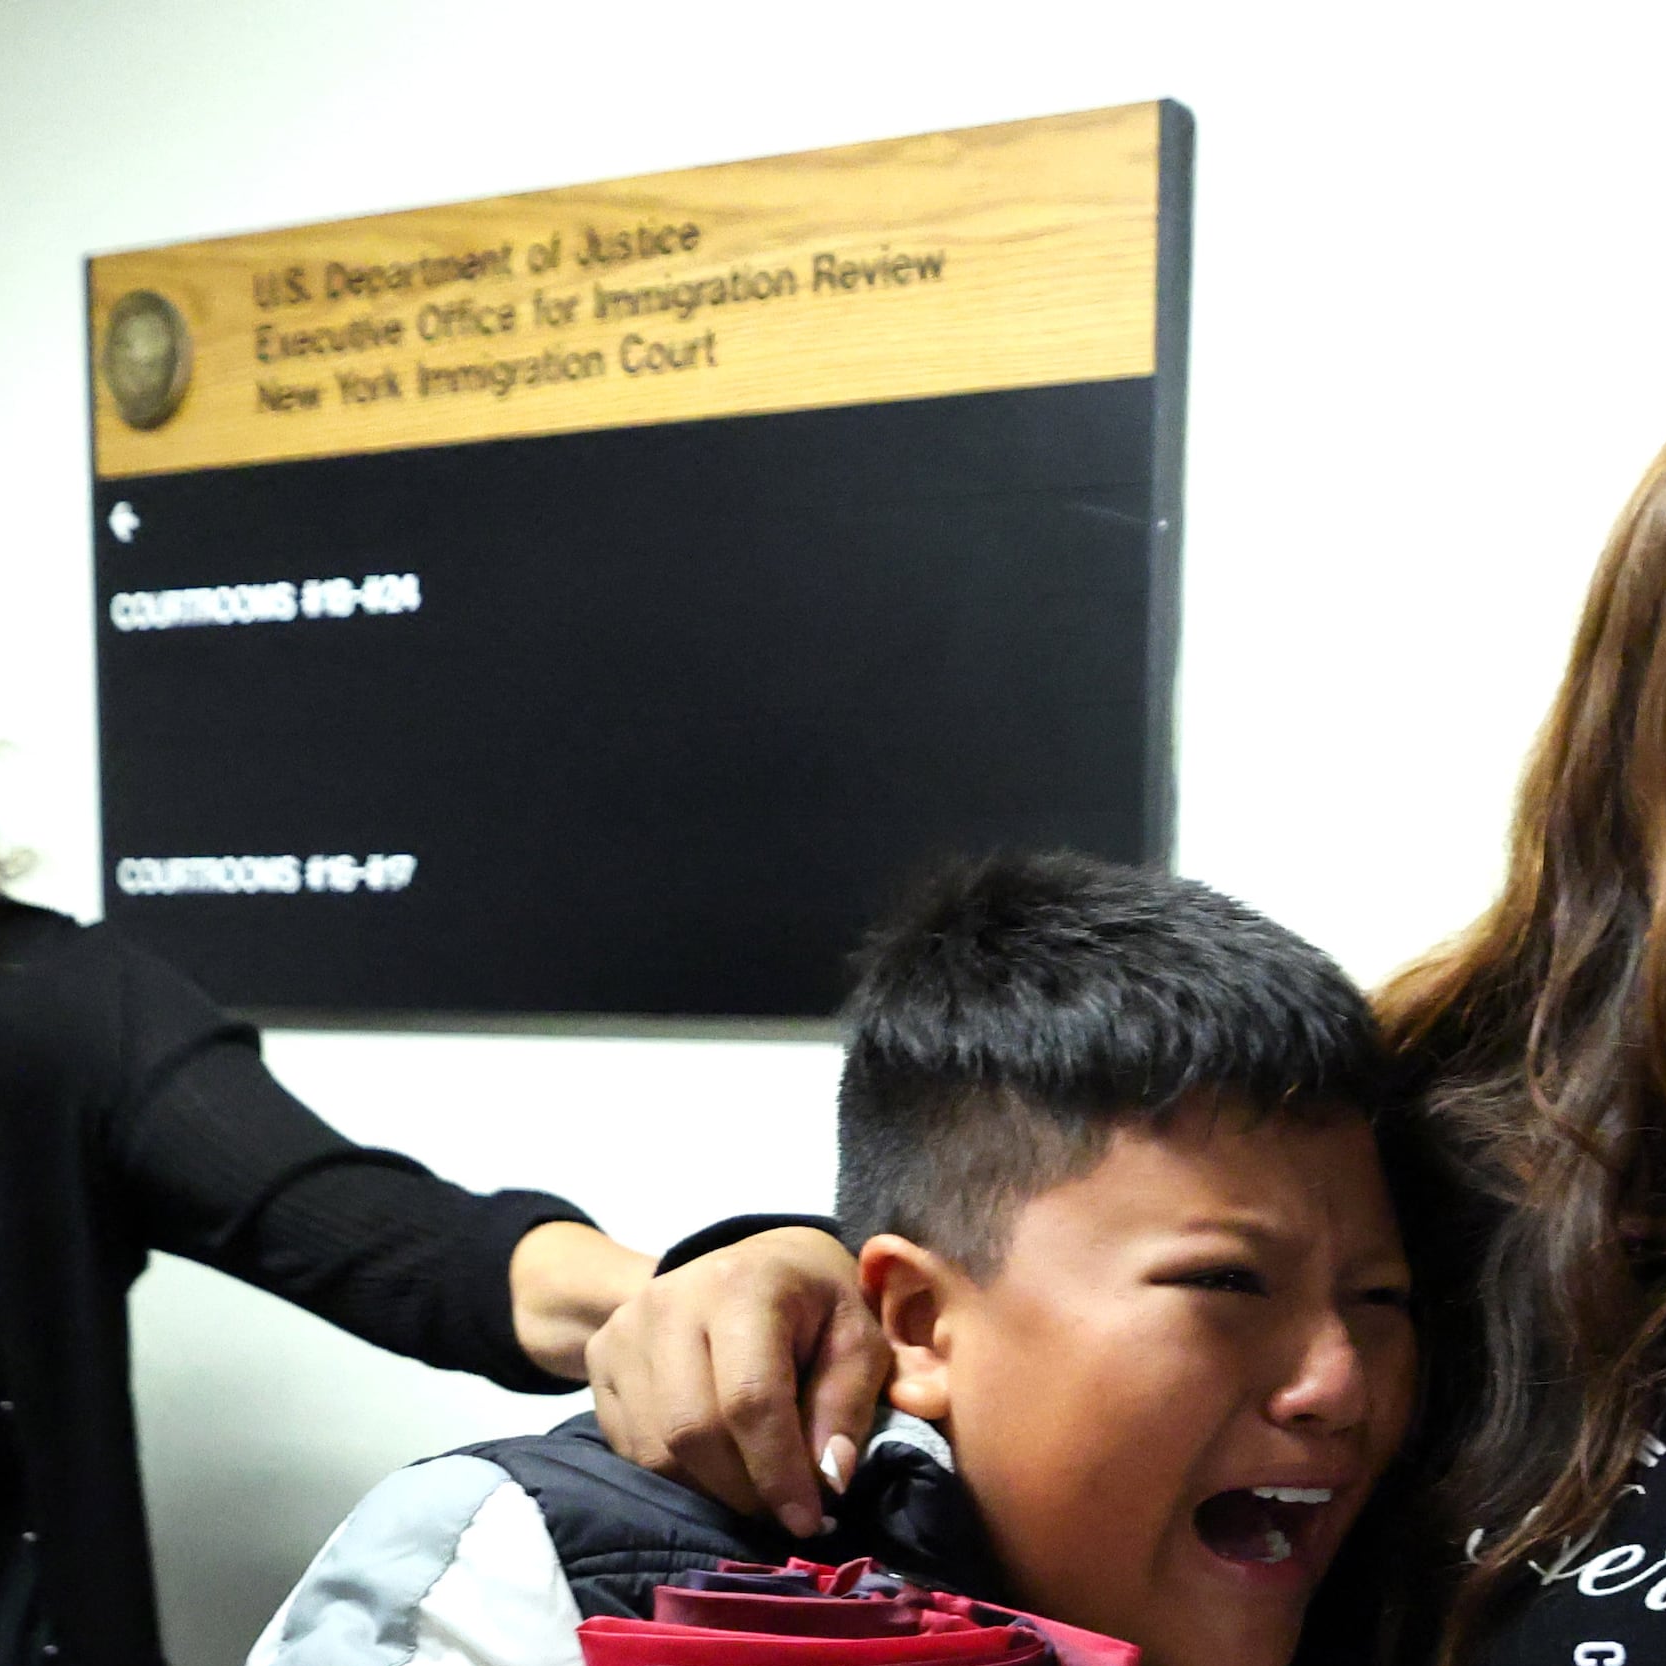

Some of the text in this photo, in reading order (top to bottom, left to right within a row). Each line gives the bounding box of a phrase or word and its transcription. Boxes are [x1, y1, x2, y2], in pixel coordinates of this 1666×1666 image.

[325, 243, 514, 300] Department
[528, 231, 562, 275] of
[579, 220, 701, 267] Justice
[255, 244, 946, 363] Executive Office for Immigration Review
[257, 330, 718, 411] New York Immigration Court
